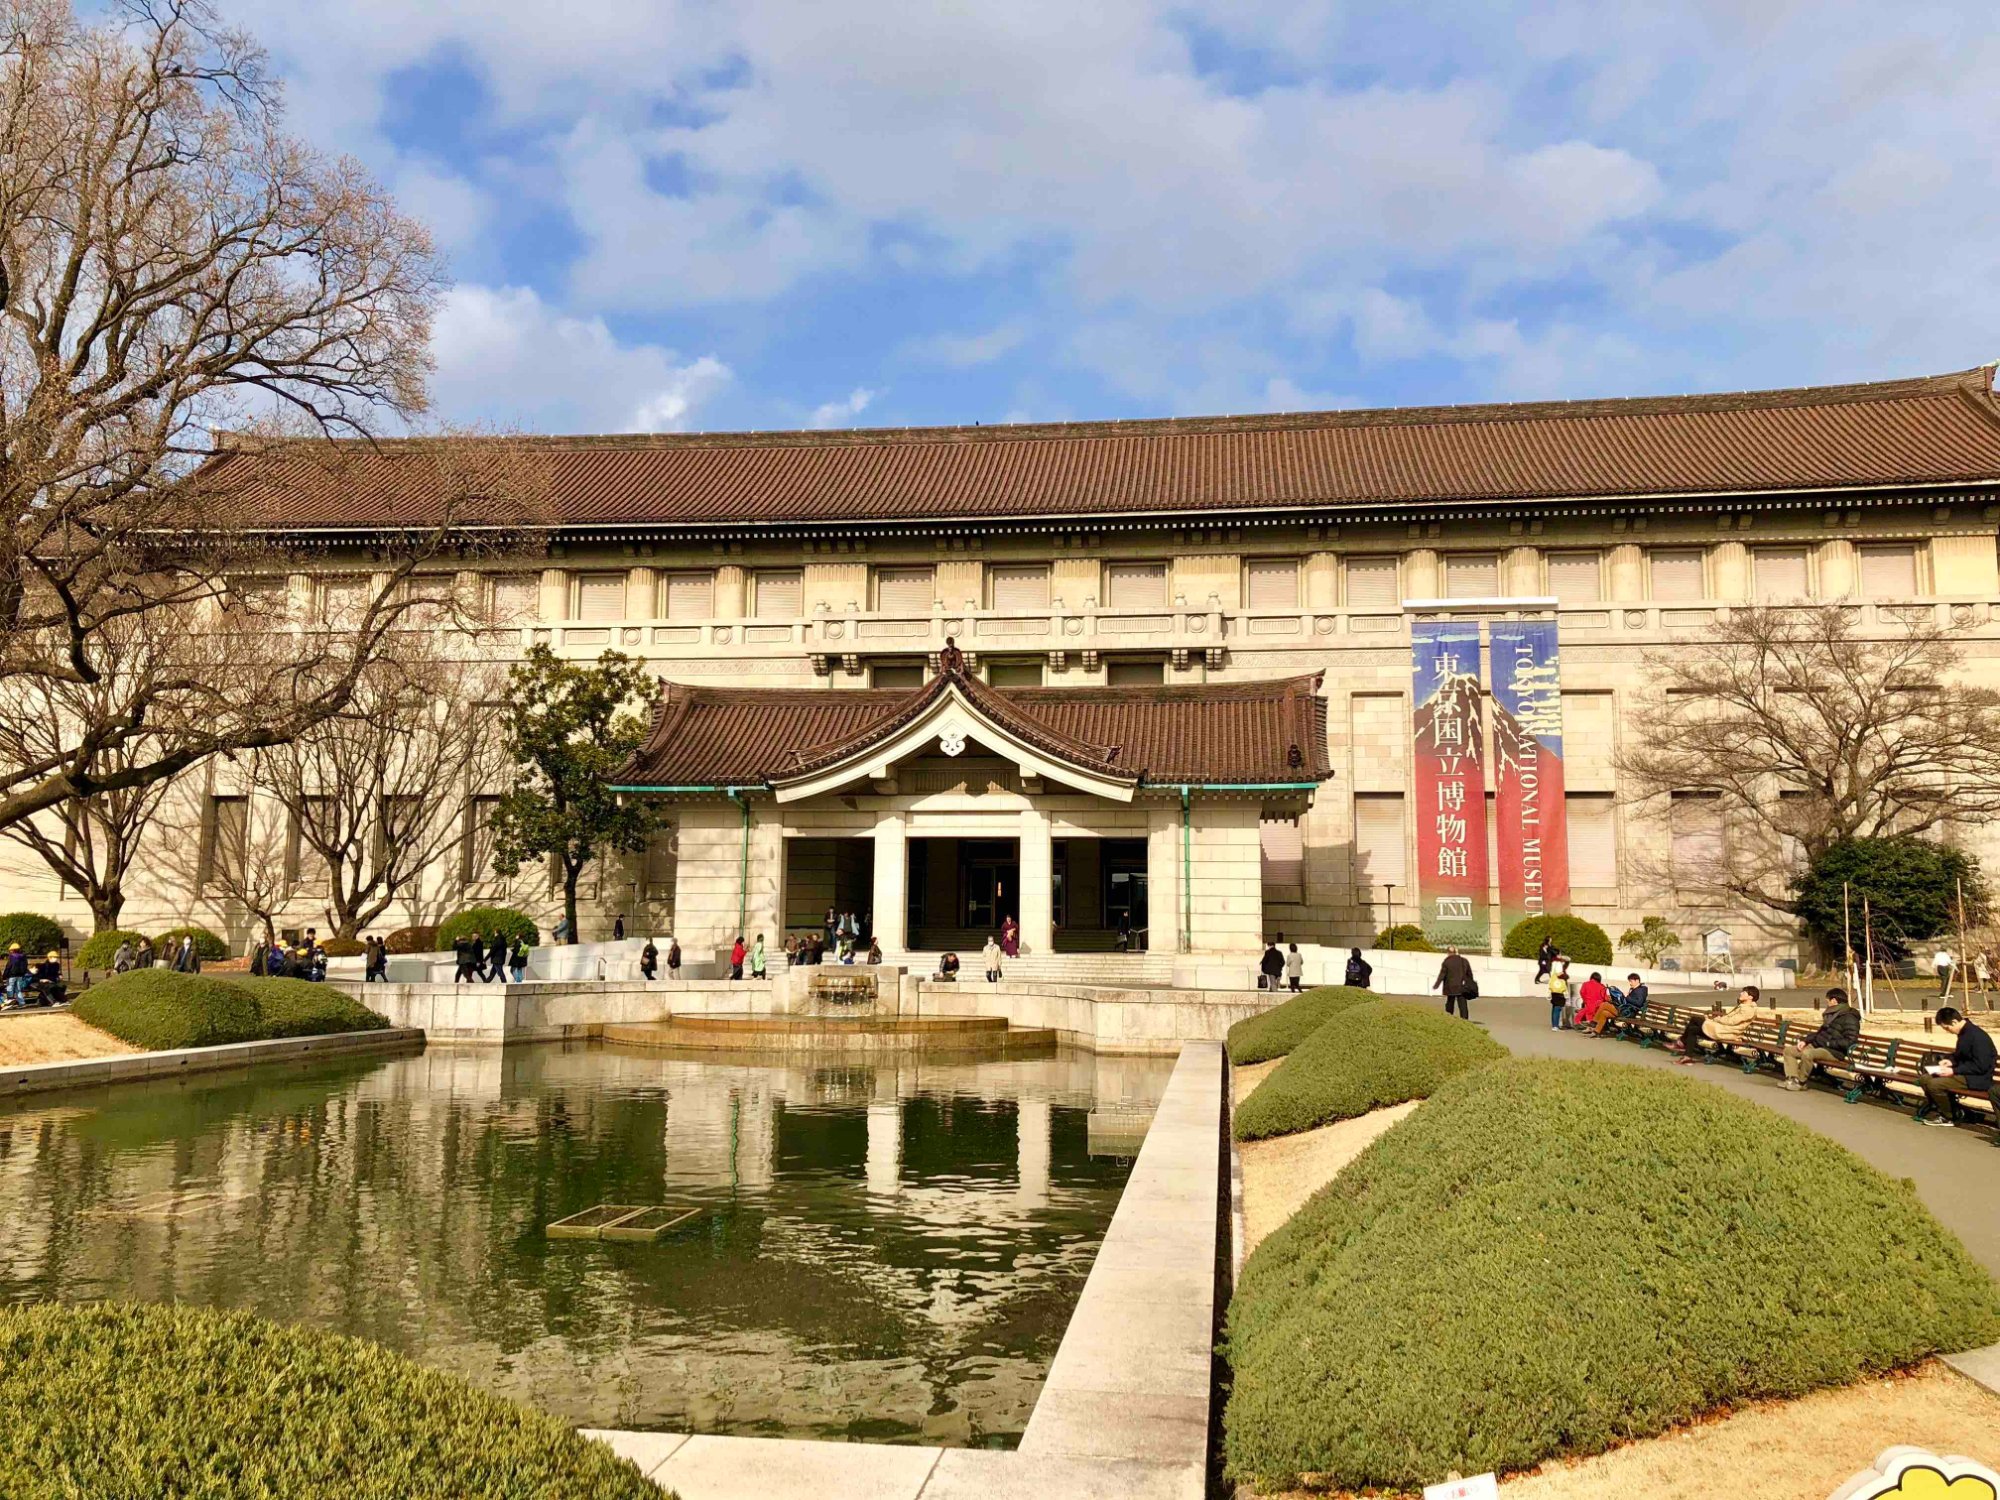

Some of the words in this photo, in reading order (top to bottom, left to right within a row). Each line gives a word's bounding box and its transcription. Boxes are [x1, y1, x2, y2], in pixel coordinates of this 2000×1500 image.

[1515, 643, 1535, 714] TOKYO
[1432, 652, 1467, 877] 東京国立博物館
[1519, 721, 1540, 830] NATIONAL
[1436, 903, 1472, 916] TNM
